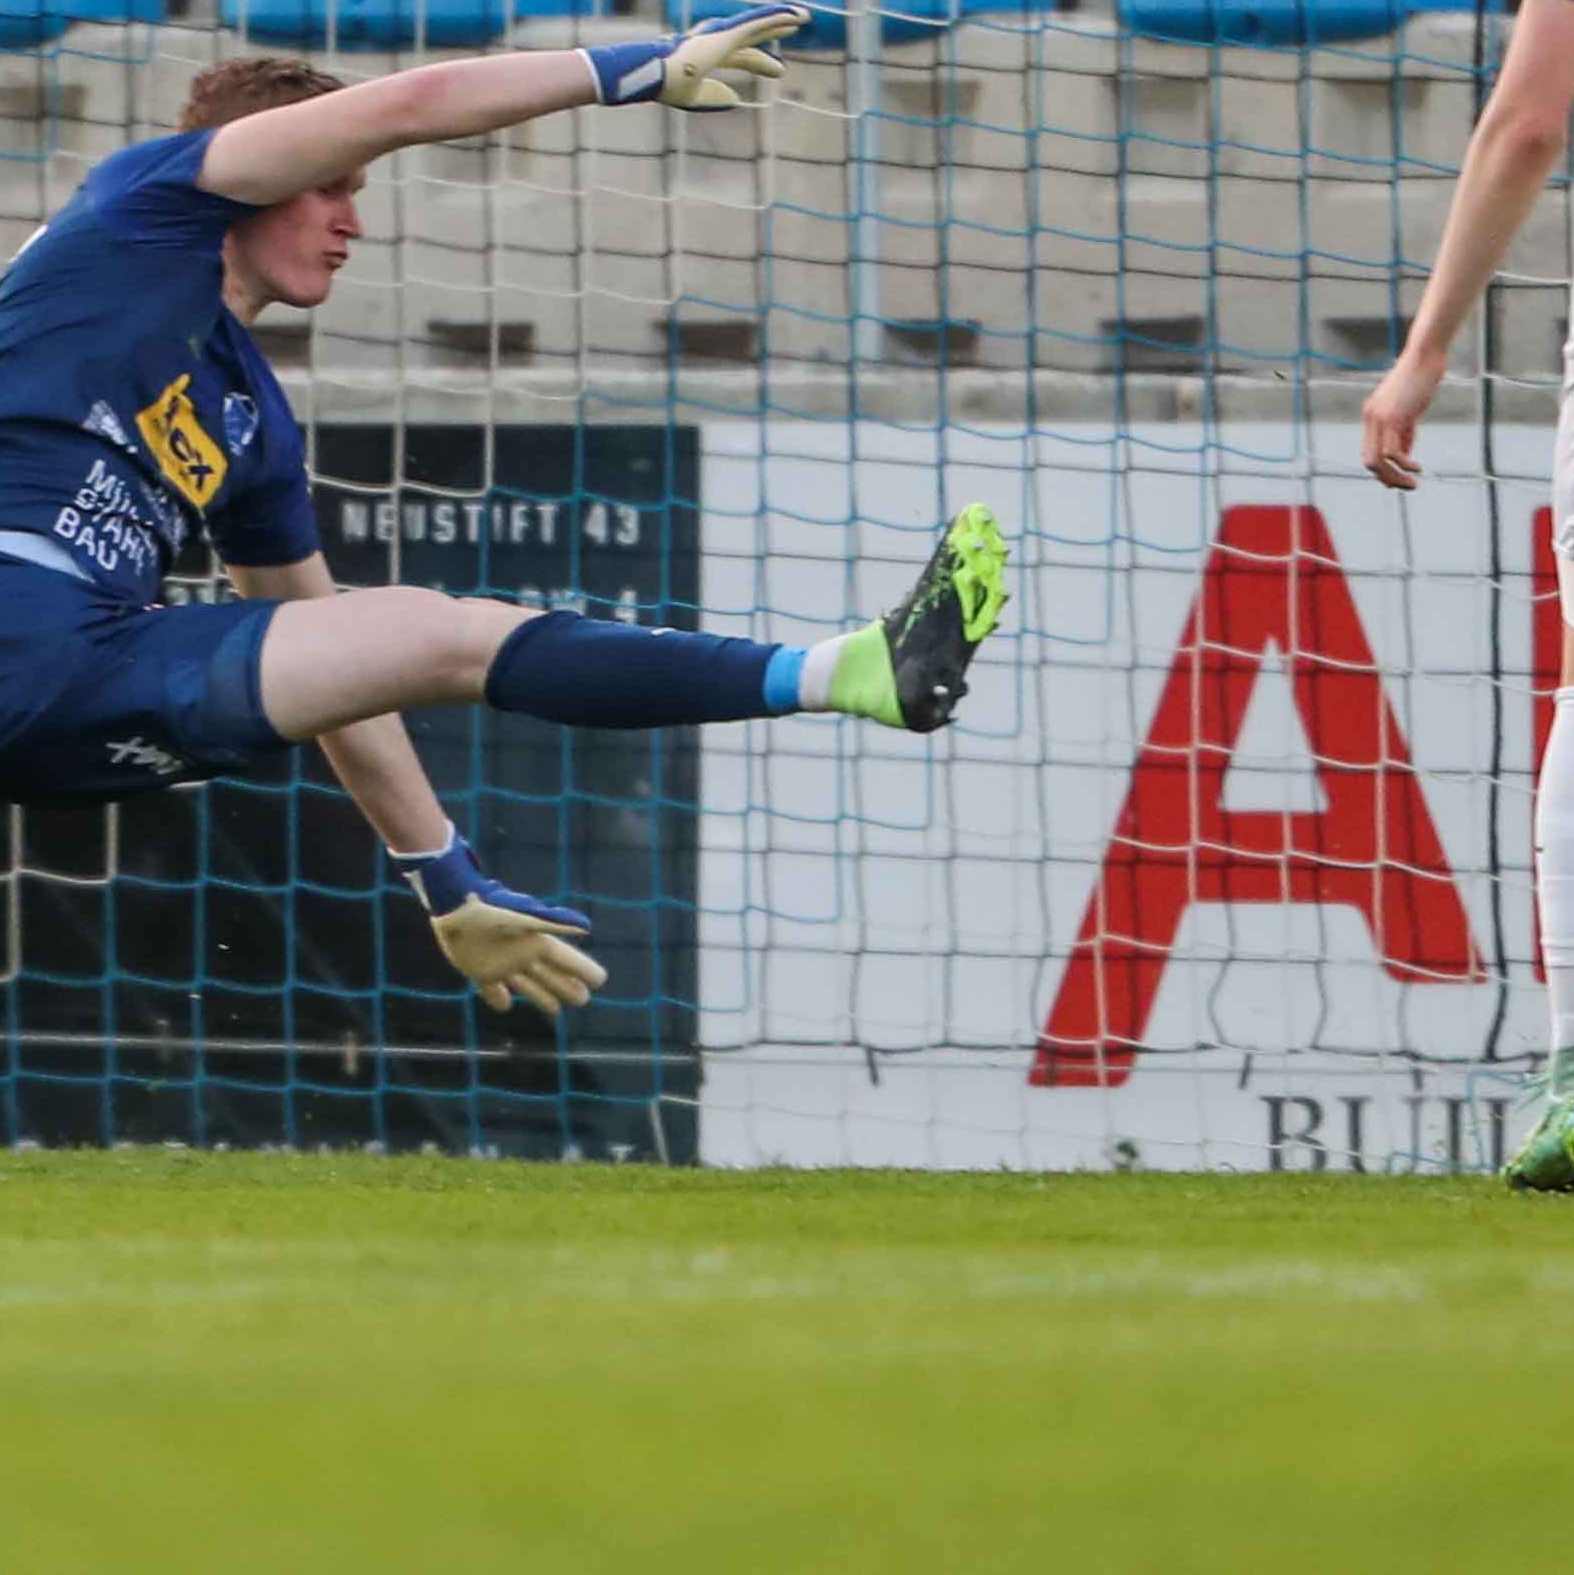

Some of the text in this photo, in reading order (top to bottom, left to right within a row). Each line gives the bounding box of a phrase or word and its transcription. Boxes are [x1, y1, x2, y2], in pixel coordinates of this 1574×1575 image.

[53, 506, 119, 571] BAU
[340, 500, 641, 544] NEUSTIFT 43
